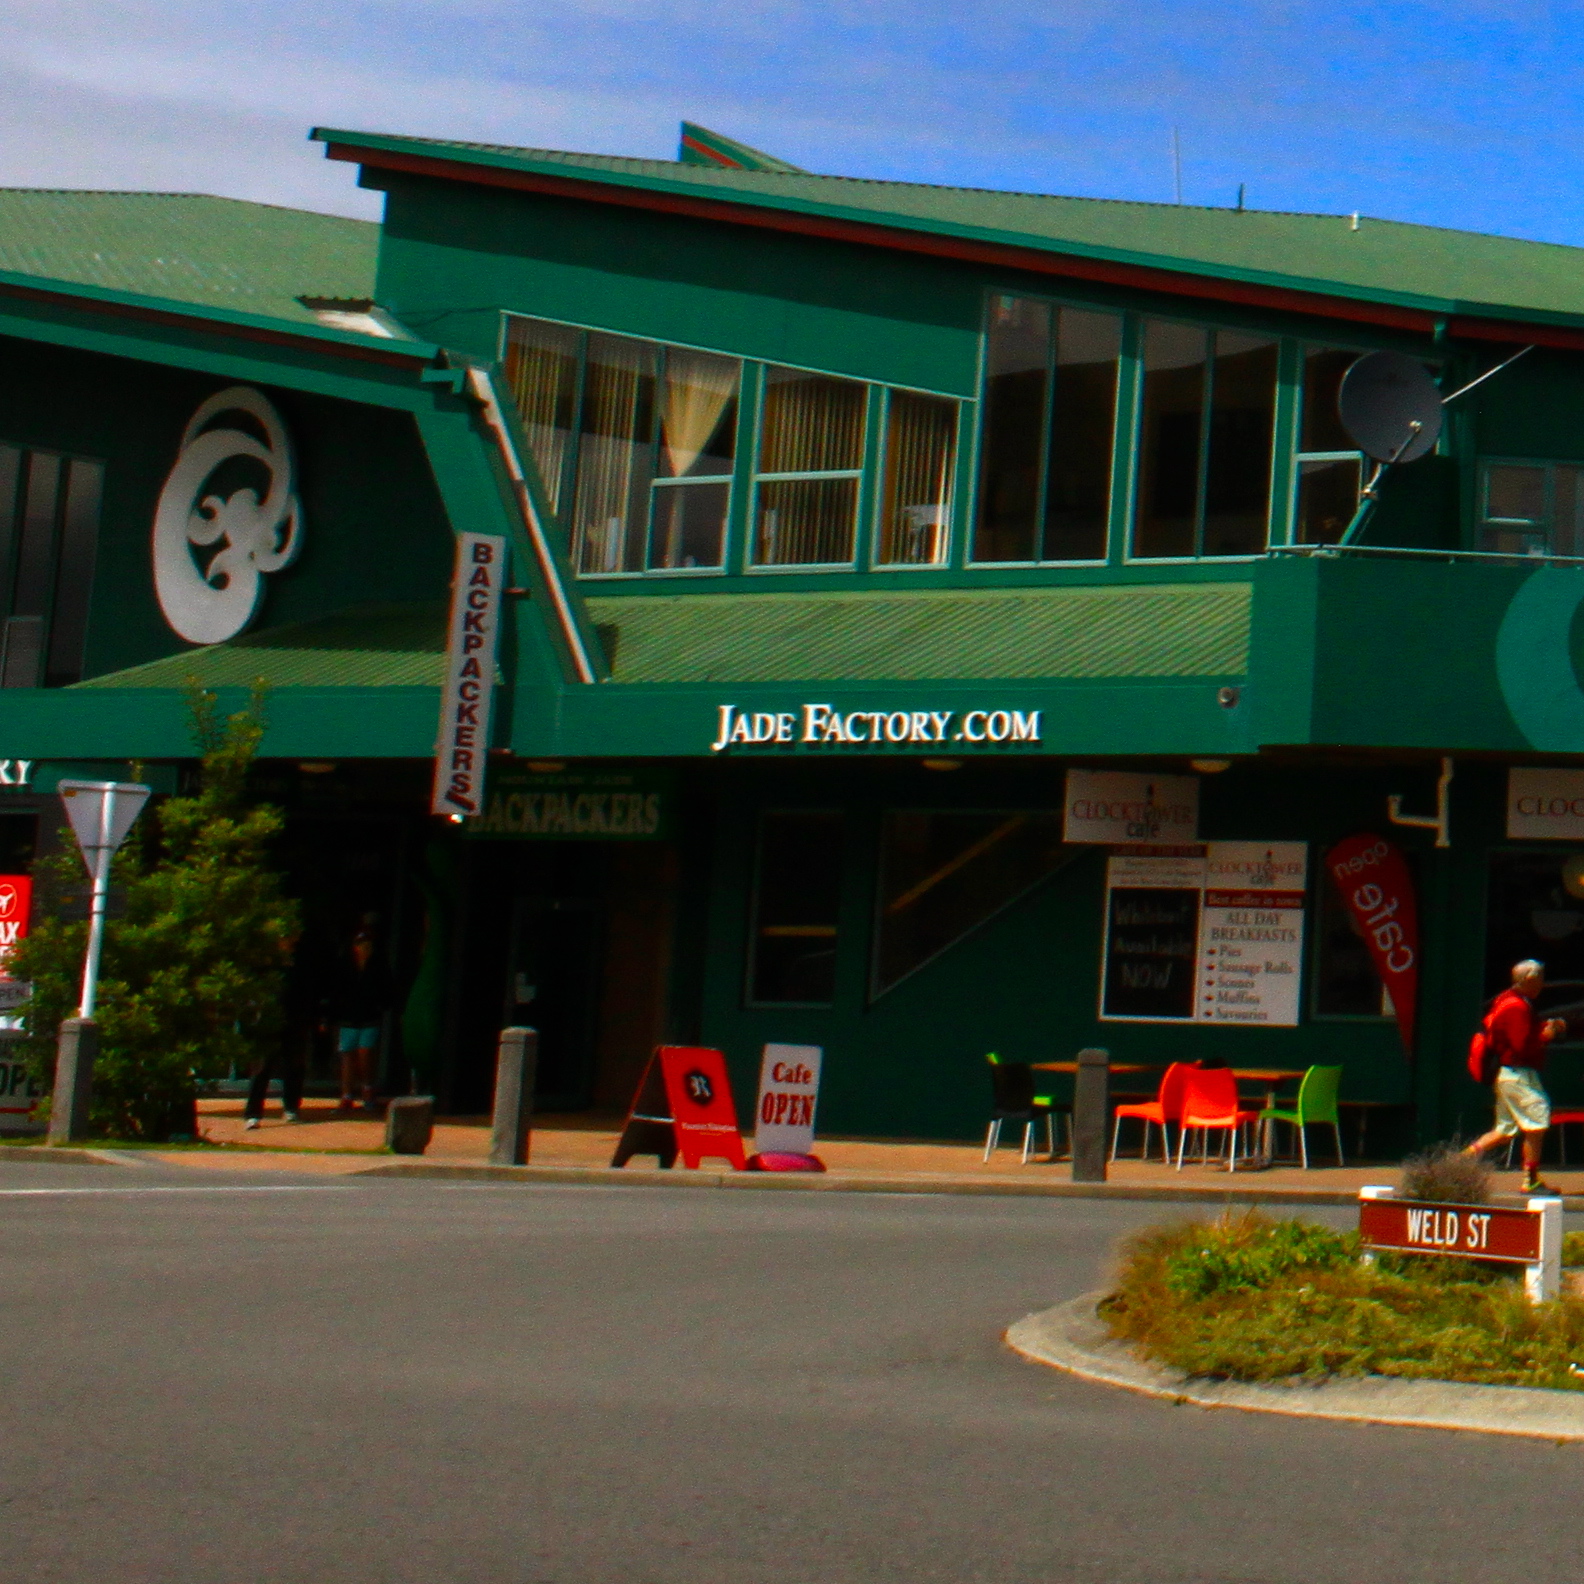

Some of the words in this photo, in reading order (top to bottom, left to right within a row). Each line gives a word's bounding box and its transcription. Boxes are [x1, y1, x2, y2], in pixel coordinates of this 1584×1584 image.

[450, 542, 494, 793] BACKPACKERS
[711, 703, 797, 751] JADE
[1211, 926, 1297, 942] BREAKFASTS
[1226, 912, 1250, 925] ALL
[1254, 912, 1283, 926] DAY
[772, 1061, 813, 1085] Cafe
[761, 1091, 816, 1128] OPEN
[1406, 1207, 1460, 1246] WELD
[1466, 1213, 1492, 1249] ST
